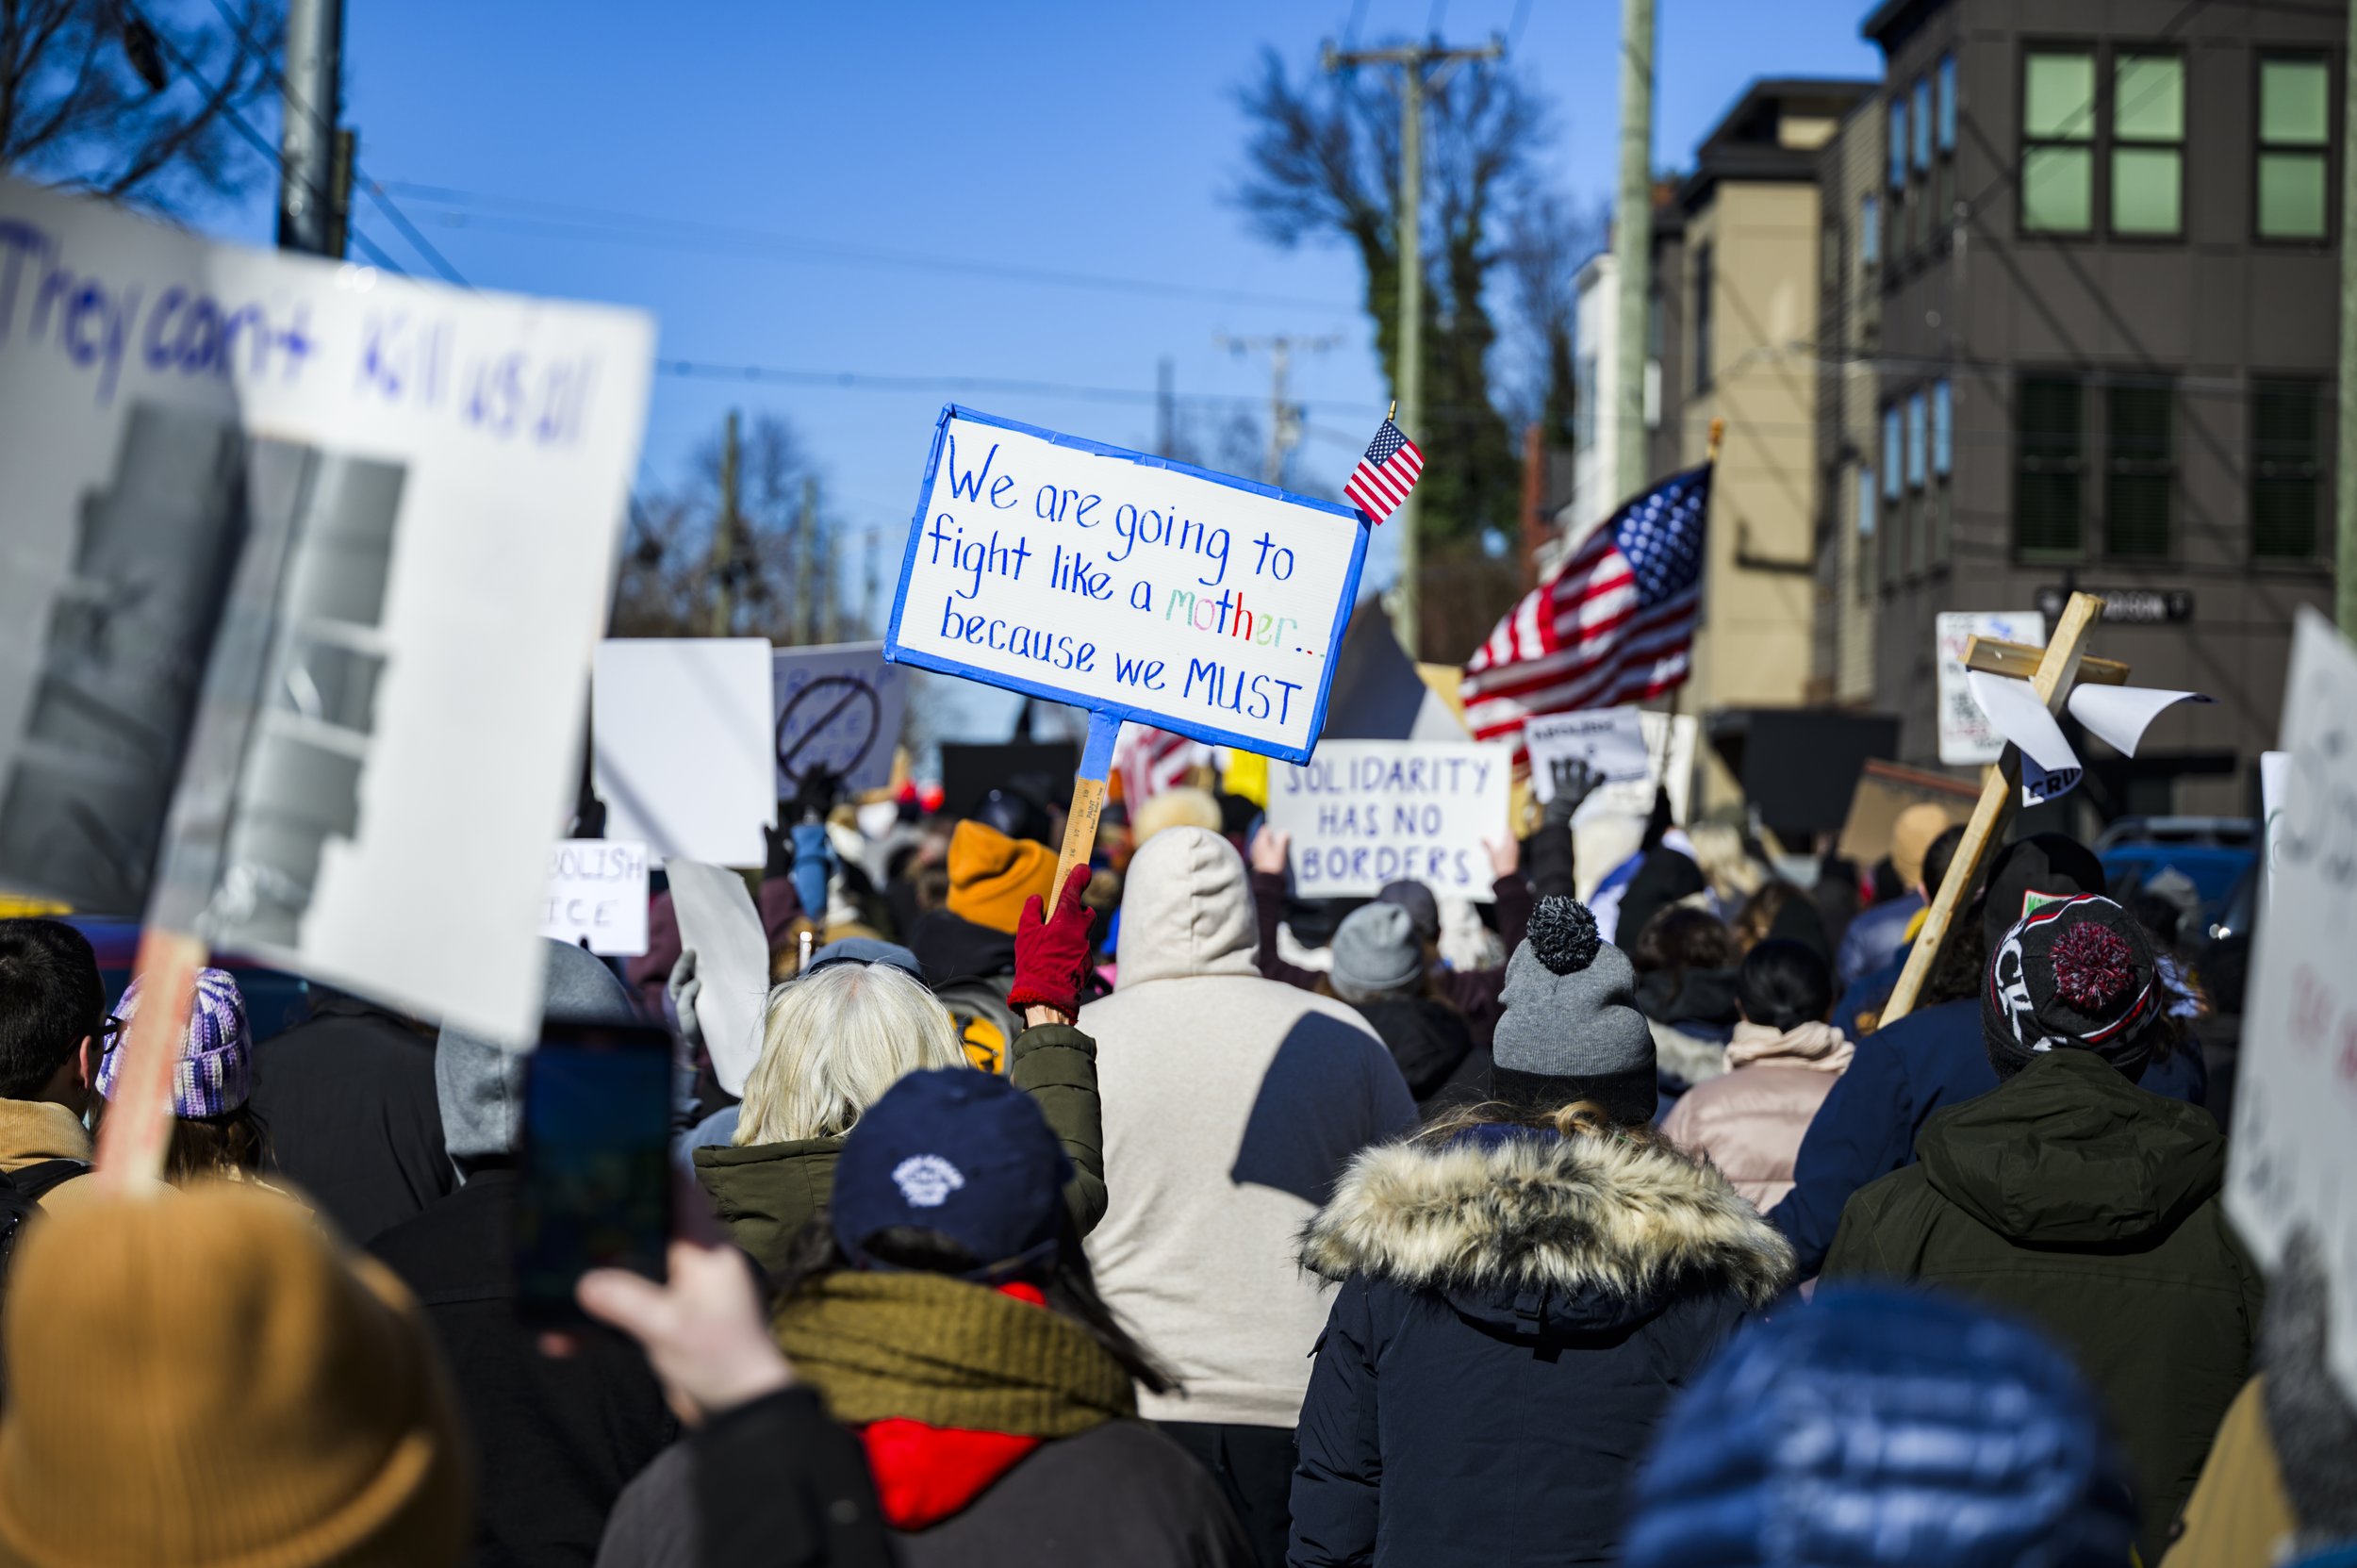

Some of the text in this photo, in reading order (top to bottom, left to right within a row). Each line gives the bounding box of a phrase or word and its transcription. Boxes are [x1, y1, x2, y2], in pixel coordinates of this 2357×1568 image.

[948, 434, 1294, 586] We are going to
[927, 512, 1032, 600] fight
[1050, 544, 1114, 601] like
[1130, 580, 1153, 613] a
[940, 596, 1303, 725] because we MUST
[1285, 757, 1491, 795] SOLIDARITY
[1317, 801, 1443, 837] HAS NO
[548, 847, 643, 883] BOLISH
[1301, 845, 1471, 884] BORDERS
[540, 896, 619, 928] ICE
